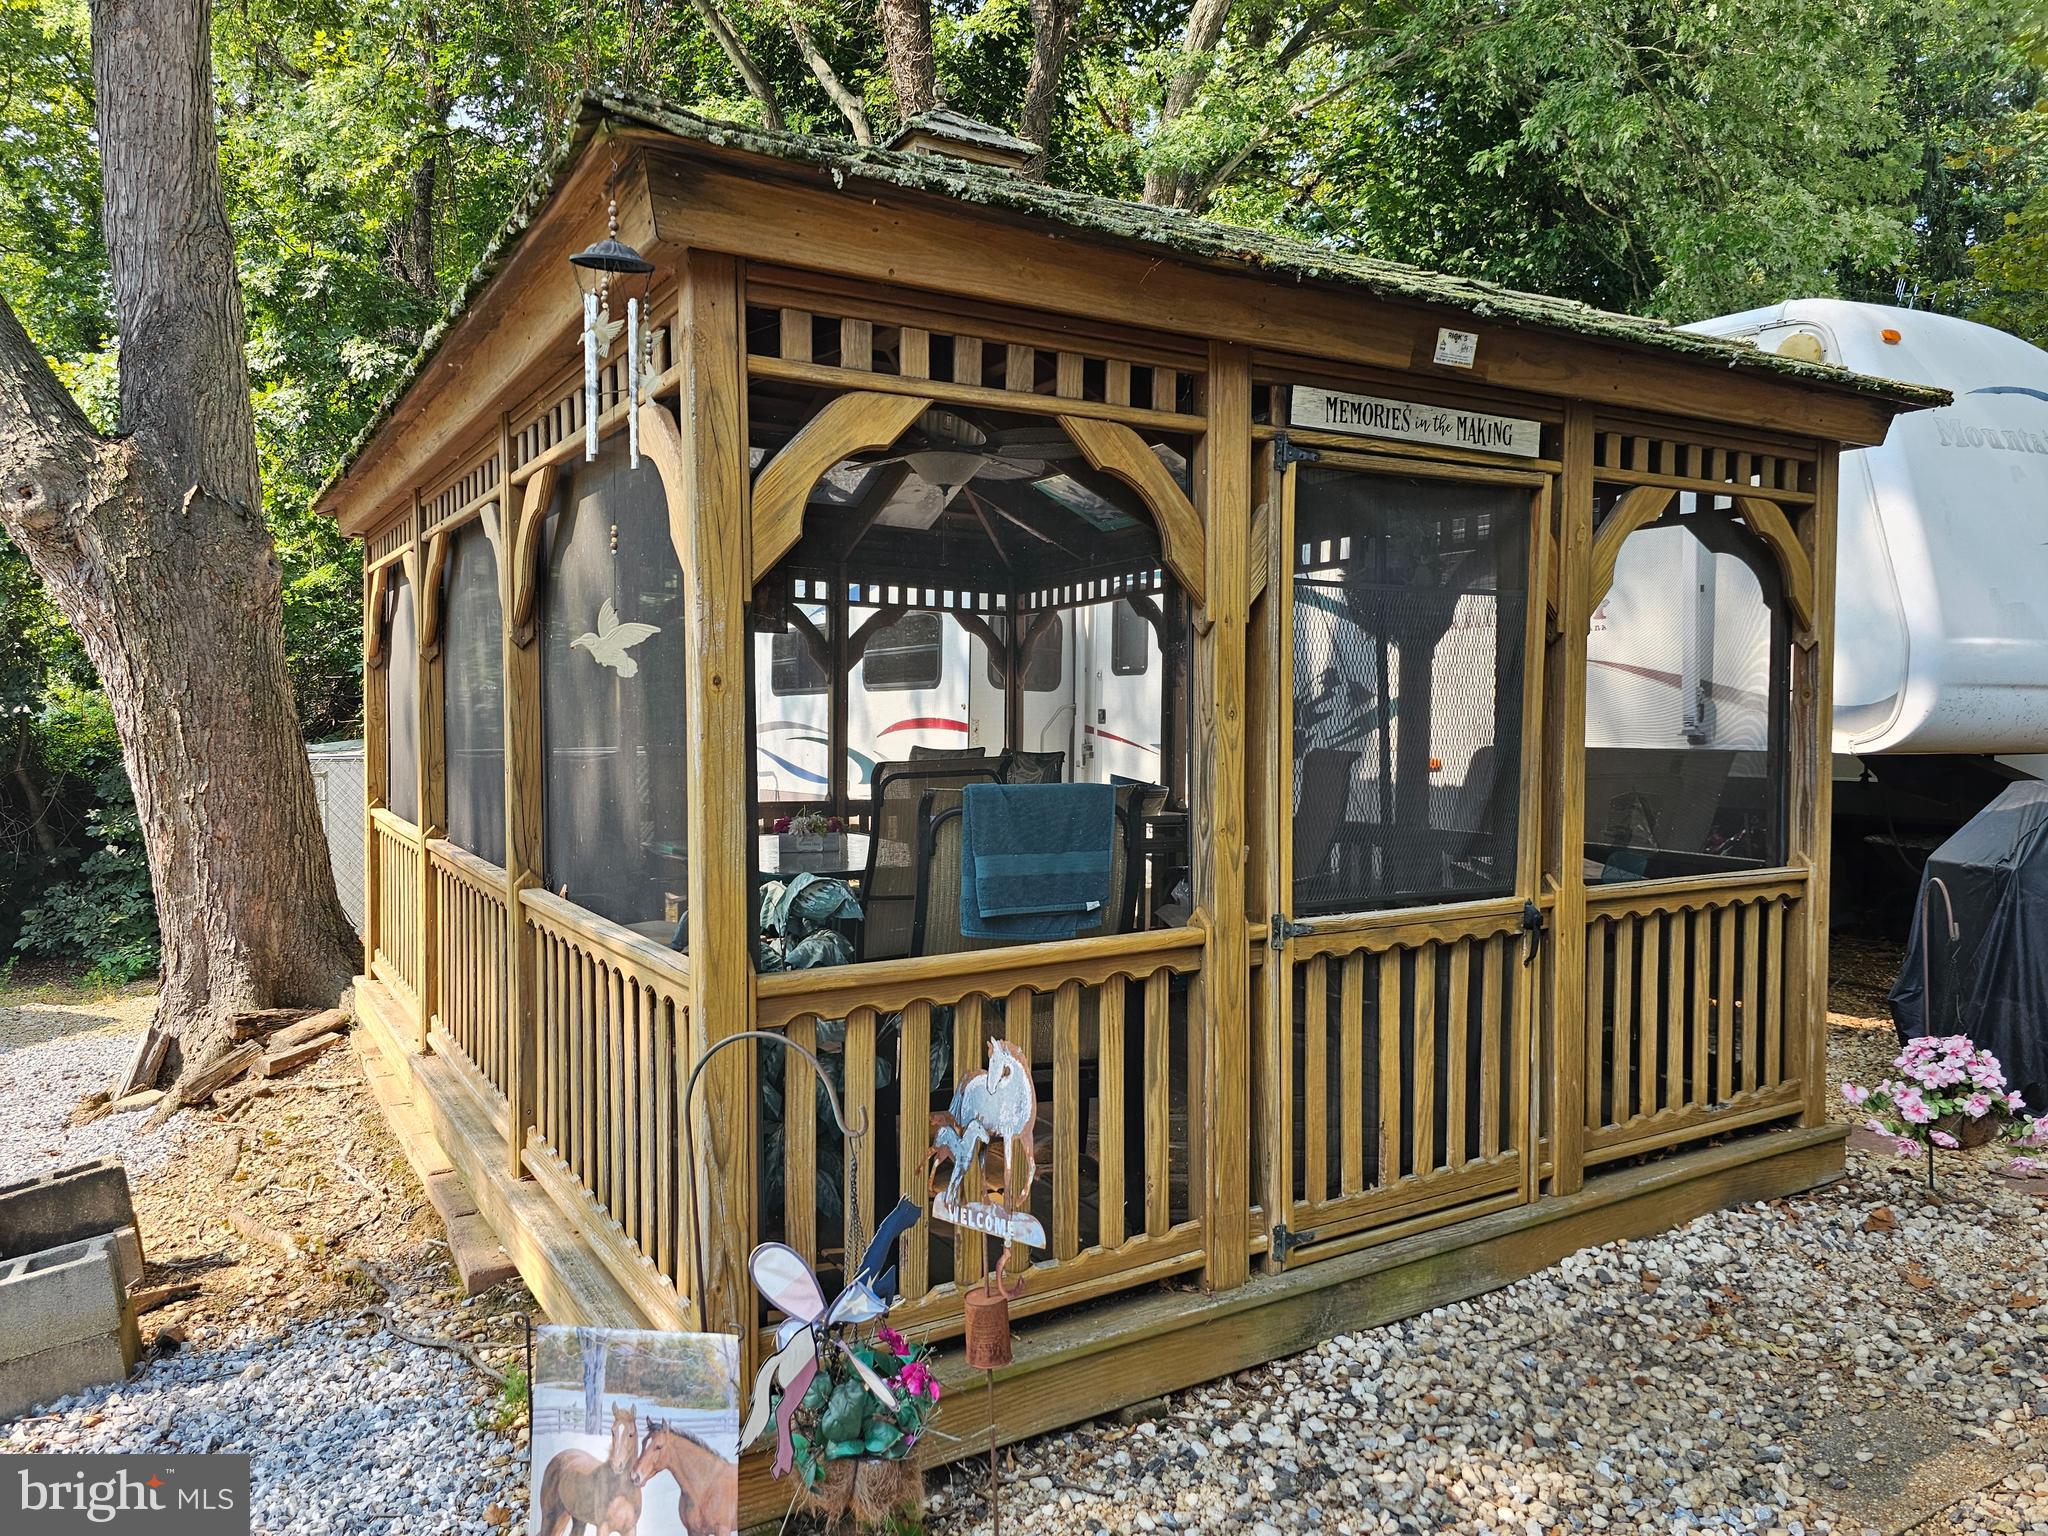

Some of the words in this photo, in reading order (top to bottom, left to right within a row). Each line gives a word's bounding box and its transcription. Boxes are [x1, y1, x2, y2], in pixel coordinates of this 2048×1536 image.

[1325, 396, 1412, 432] MEMORIES
[1414, 416, 1432, 433] in
[1432, 413, 1453, 436] the
[1456, 415, 1513, 447] MAKING
[947, 1203, 1015, 1237] WELCOME
